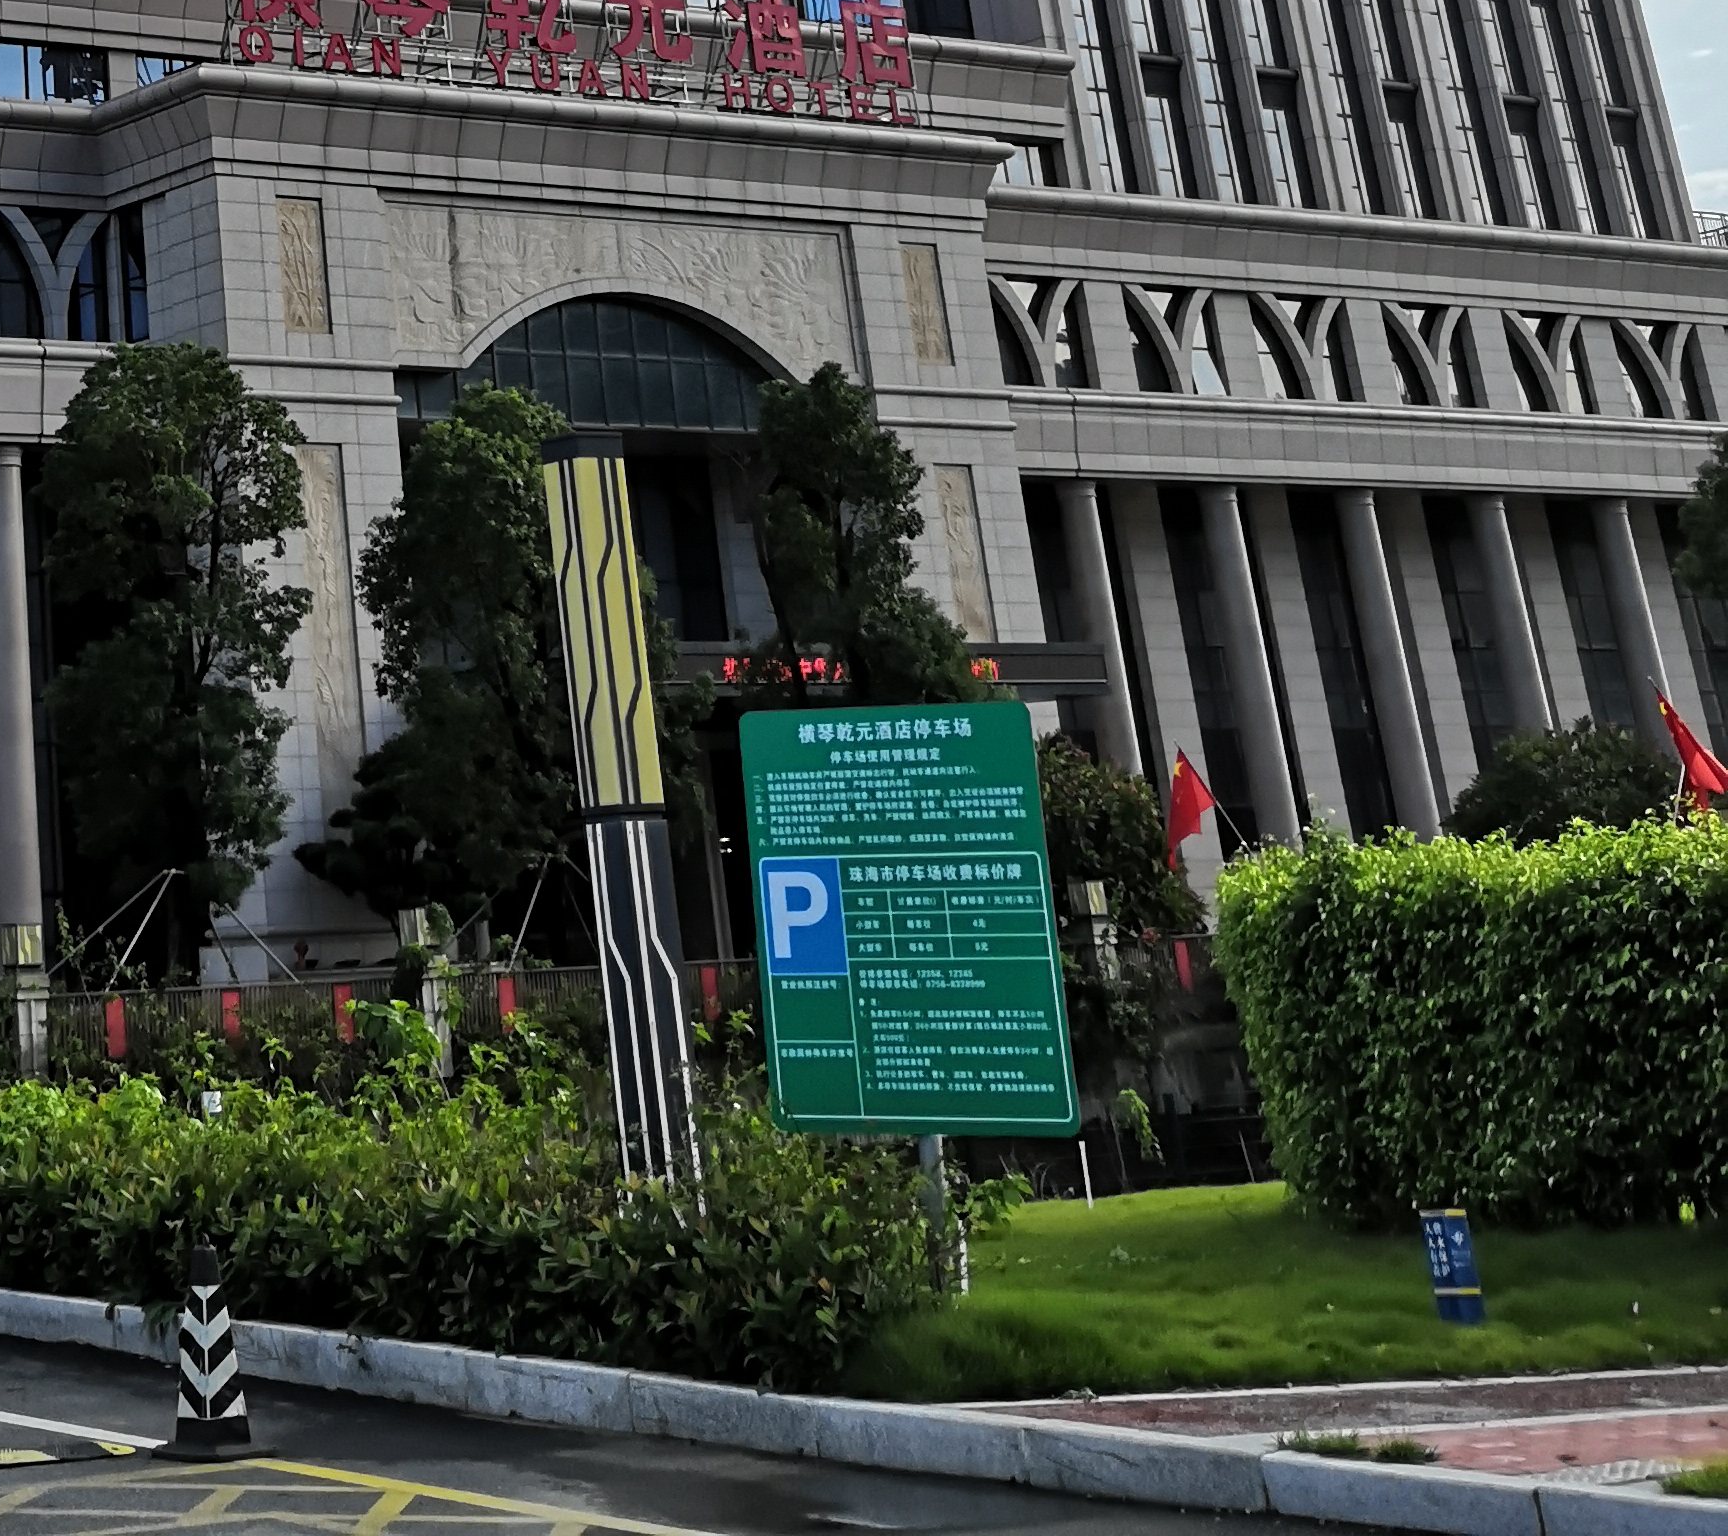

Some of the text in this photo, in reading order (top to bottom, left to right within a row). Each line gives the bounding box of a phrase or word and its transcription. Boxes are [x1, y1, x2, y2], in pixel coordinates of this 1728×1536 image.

[238, 24, 917, 125] QIAN YUAN HOTEL
[798, 717, 972, 744] 横琴乾元酒店停车场
[829, 747, 941, 764] 停车场使用管理规定
[848, 863, 1023, 883] 珠海市停车场收费标价牌
[767, 871, 829, 959] P
